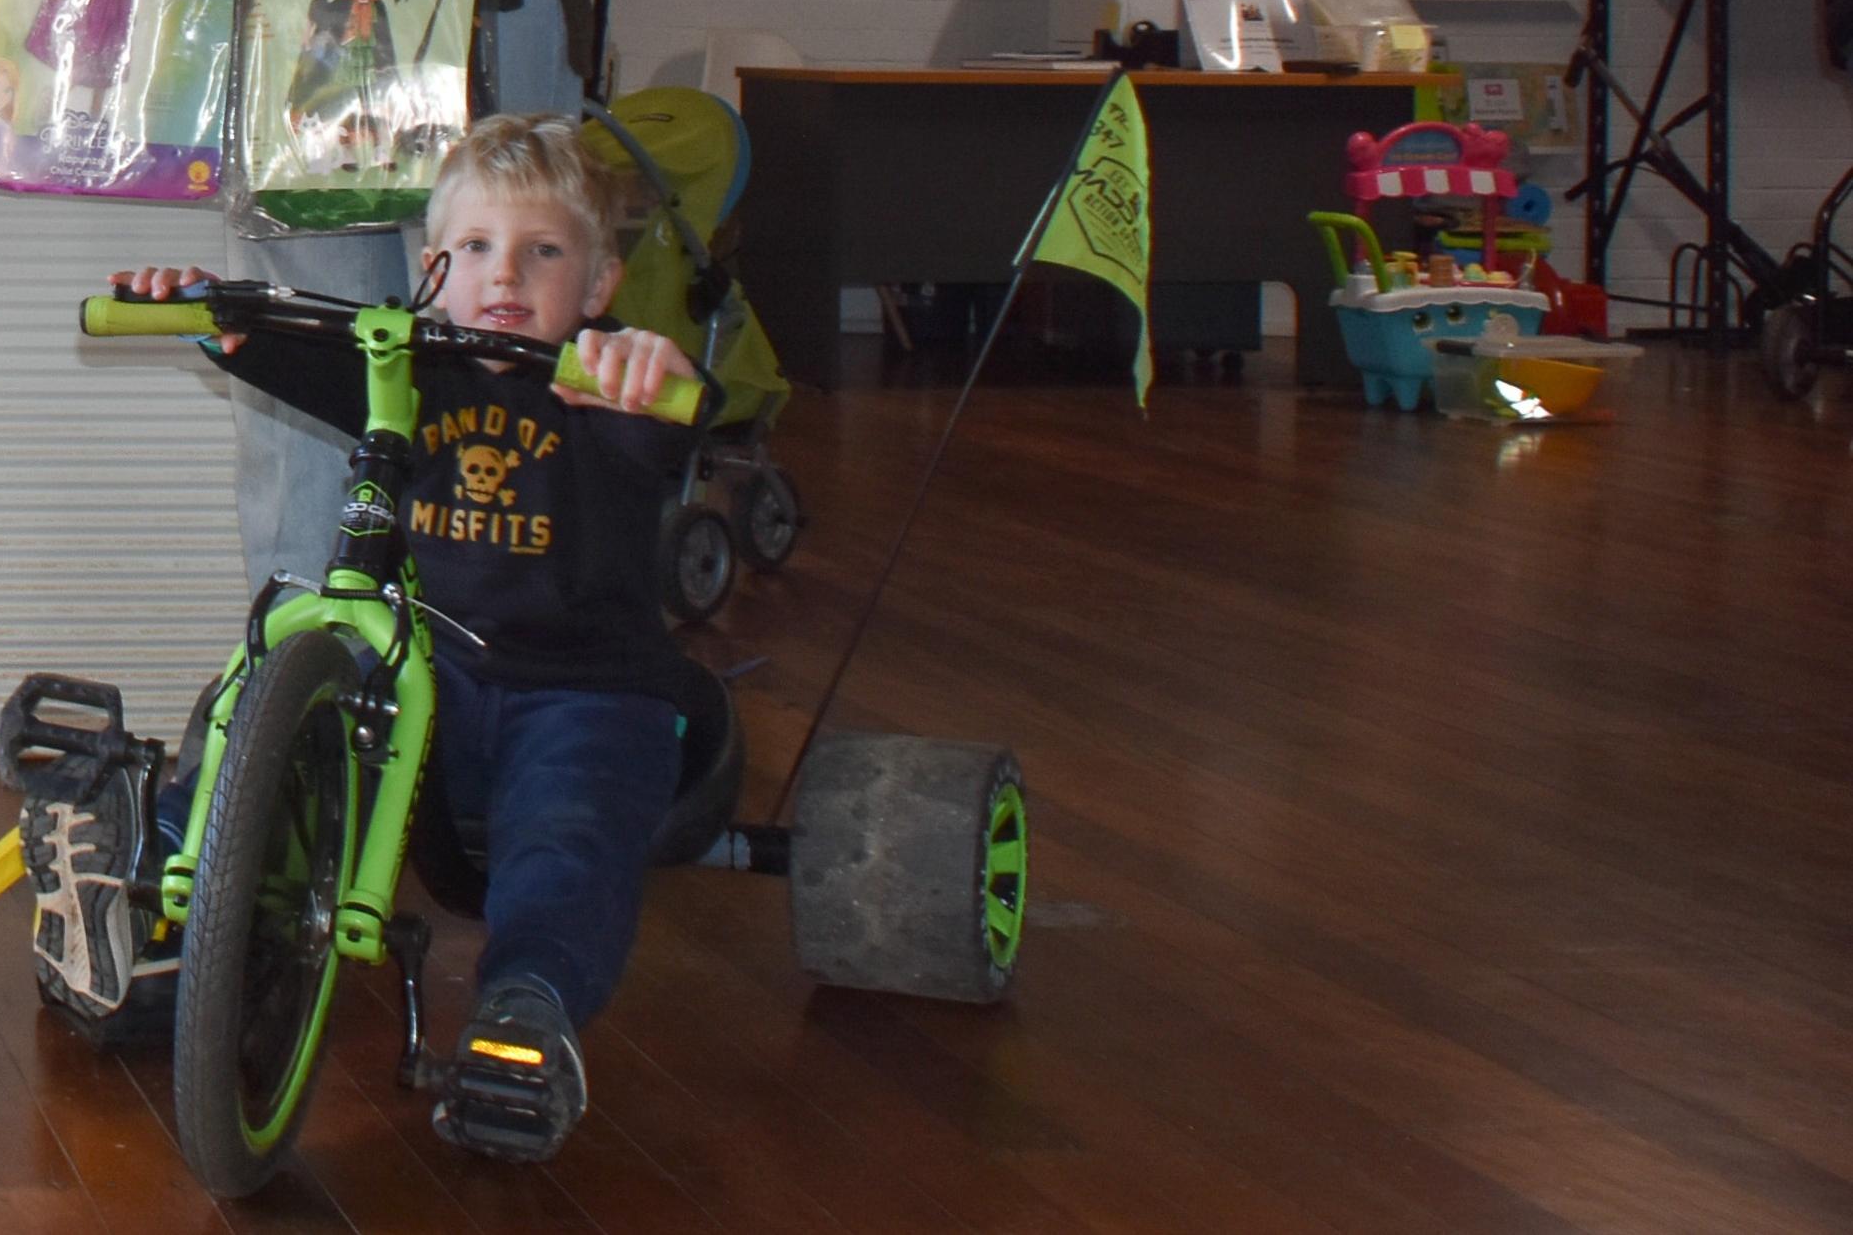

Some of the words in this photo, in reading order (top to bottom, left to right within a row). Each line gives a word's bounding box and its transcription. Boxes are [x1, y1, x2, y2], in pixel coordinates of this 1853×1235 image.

[422, 404, 507, 455] BAND
[518, 417, 562, 460] OF
[410, 499, 552, 547] MISFITS
